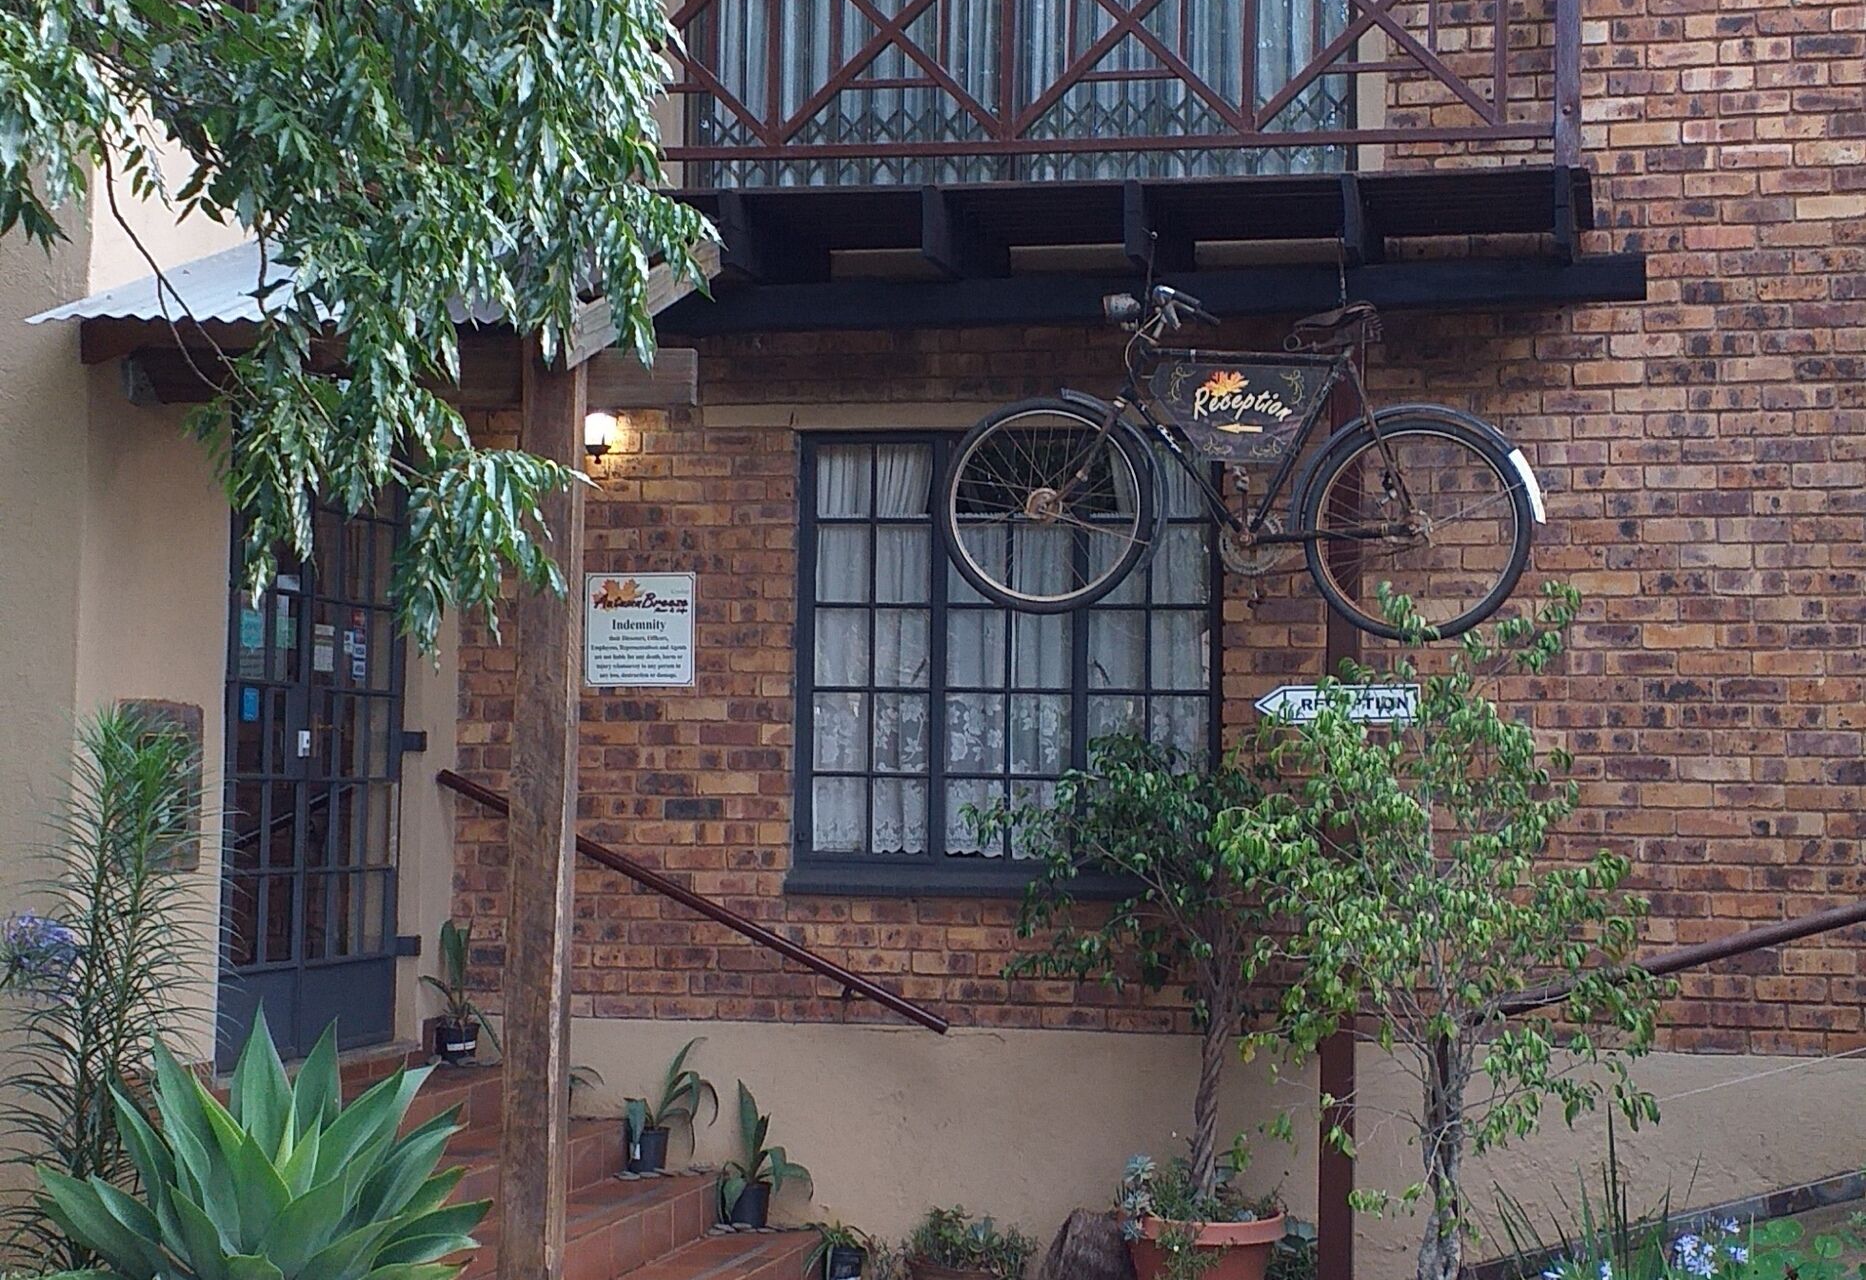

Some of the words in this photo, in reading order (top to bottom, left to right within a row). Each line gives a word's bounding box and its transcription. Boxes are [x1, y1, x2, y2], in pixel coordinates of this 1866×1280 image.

[1193, 386, 1293, 421] Reception
[611, 618, 666, 632] Indemnity
[1301, 697, 1408, 711] RECPTION
